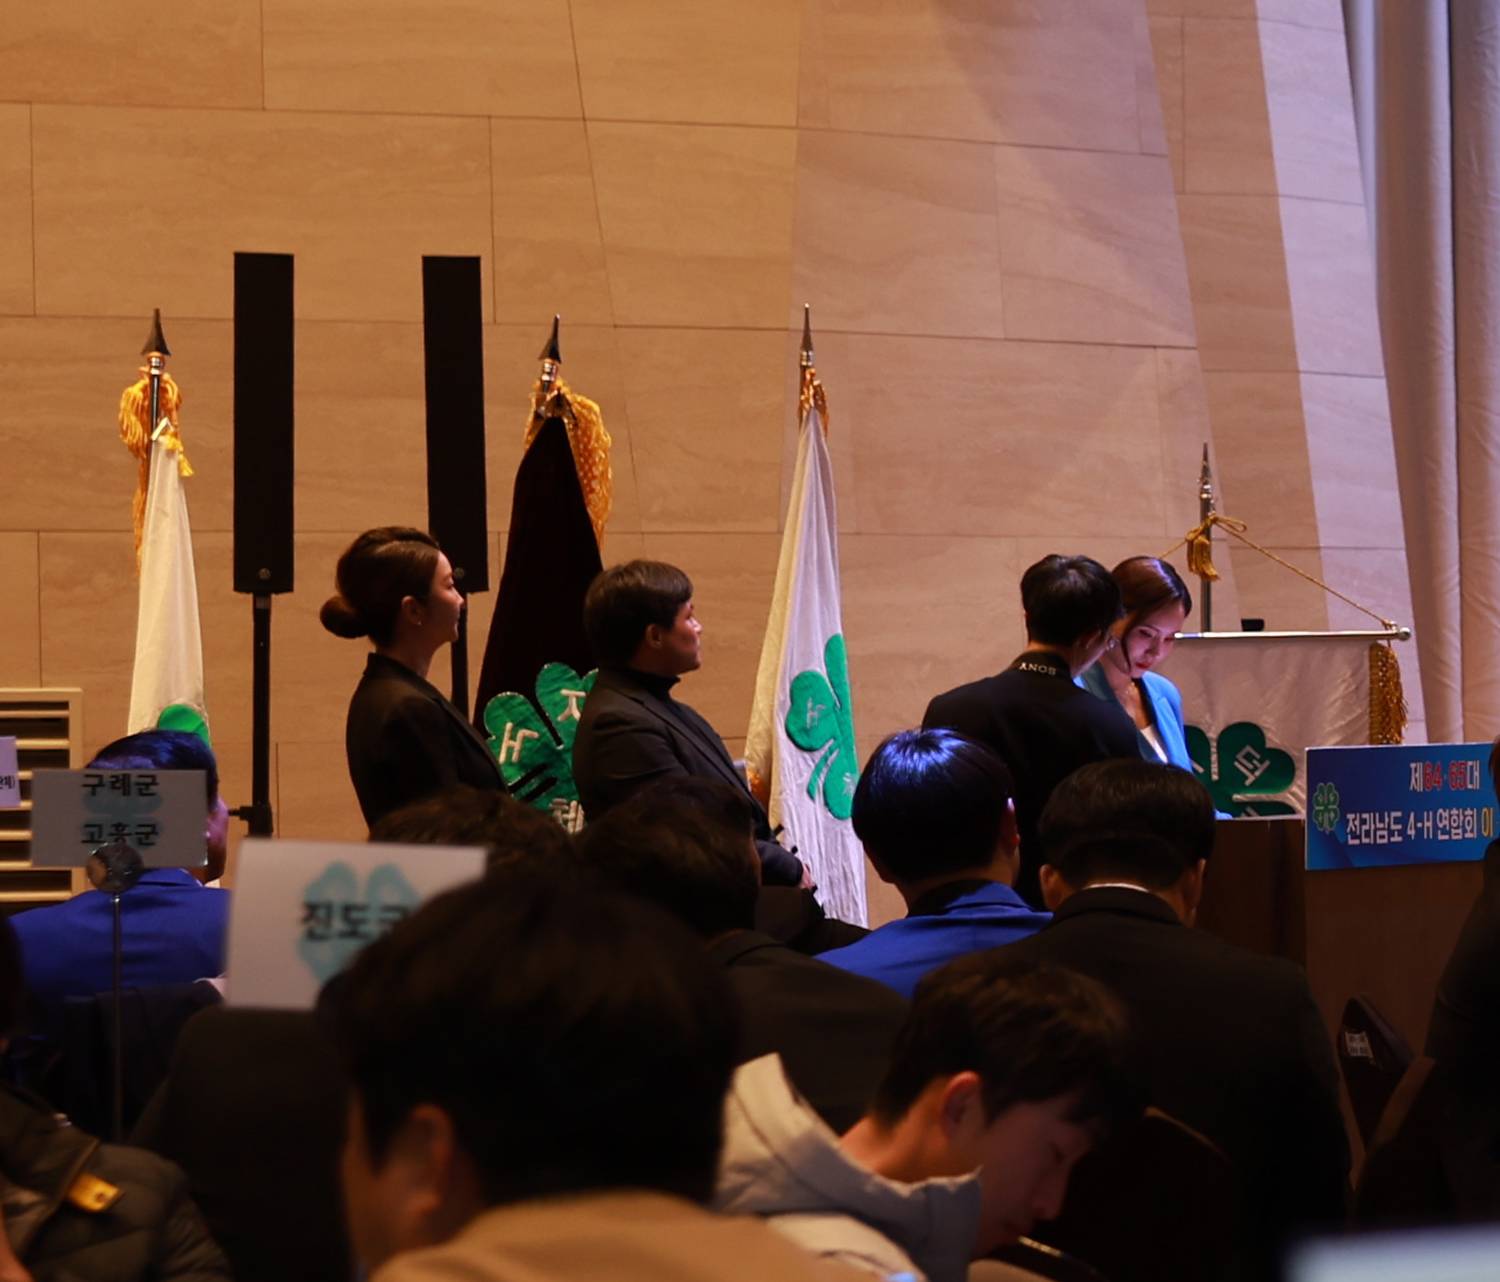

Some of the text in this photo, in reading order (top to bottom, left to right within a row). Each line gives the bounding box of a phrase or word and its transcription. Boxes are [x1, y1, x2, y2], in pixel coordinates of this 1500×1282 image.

[81, 773, 159, 797] 구례군
[81, 821, 159, 846] 고흥군
[1346, 811, 1403, 846] 전라남도
[1406, 811, 1434, 840] 4-H
[1436, 807, 1478, 840] 연합회
